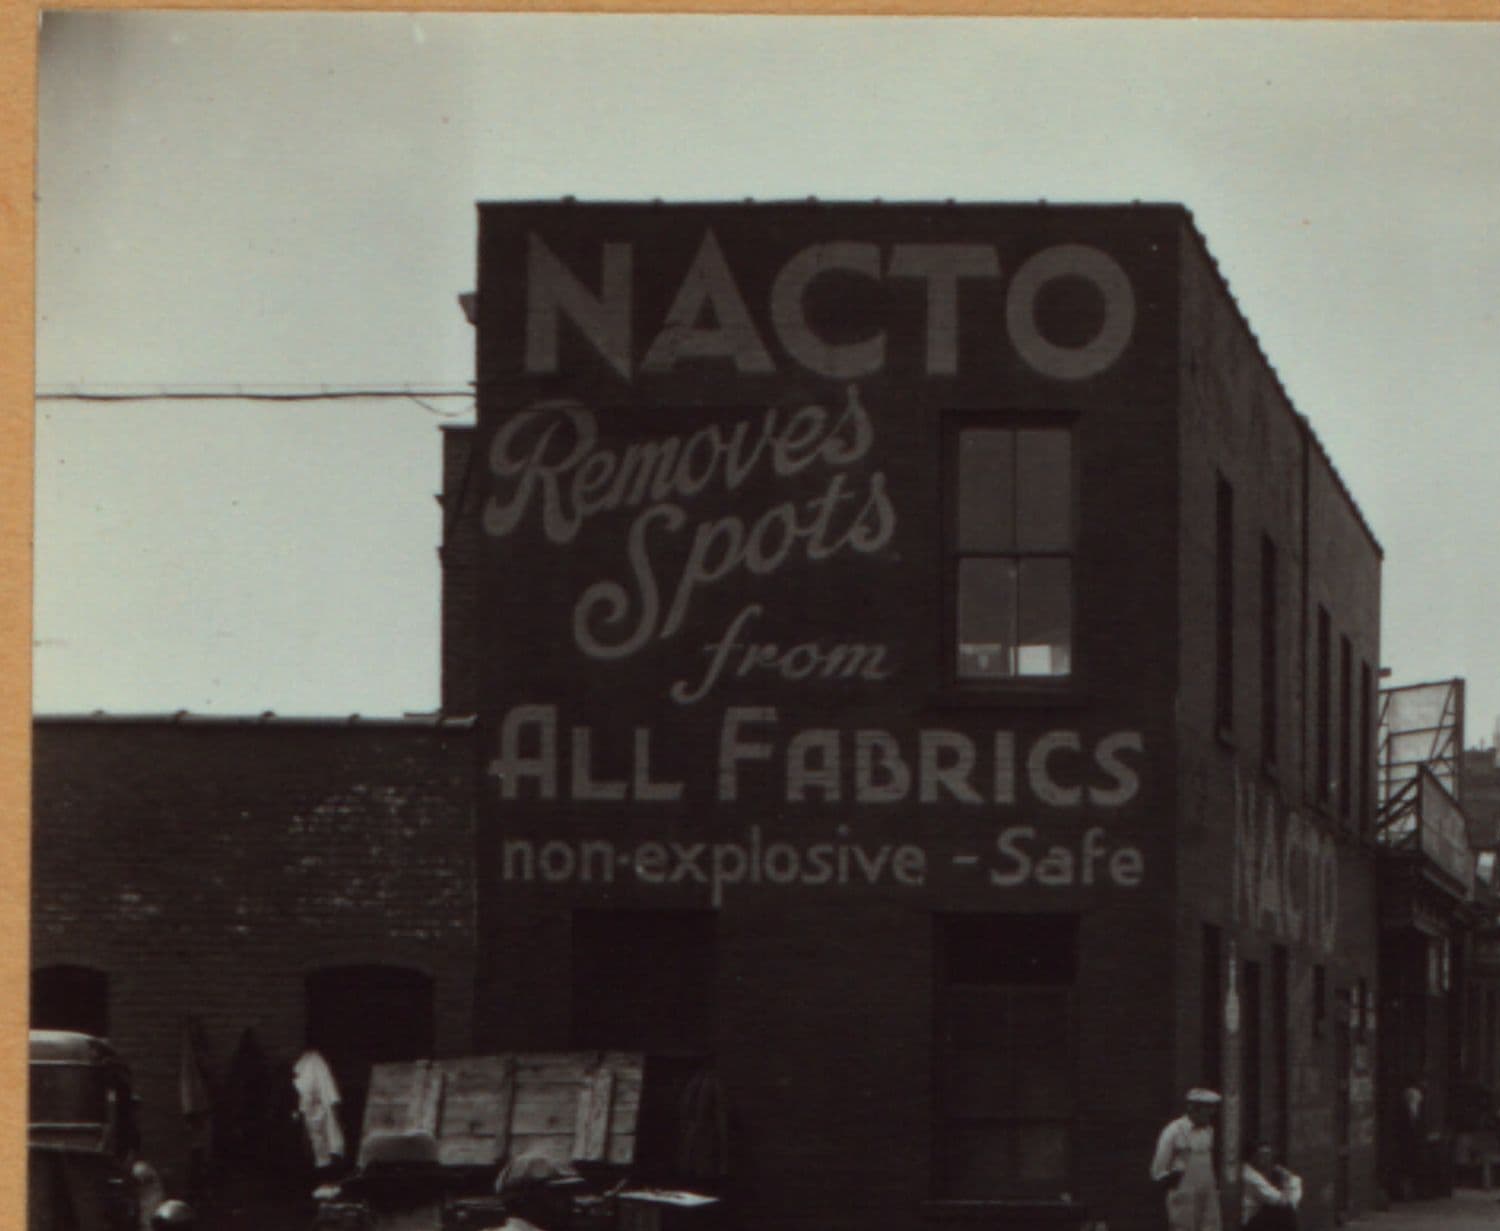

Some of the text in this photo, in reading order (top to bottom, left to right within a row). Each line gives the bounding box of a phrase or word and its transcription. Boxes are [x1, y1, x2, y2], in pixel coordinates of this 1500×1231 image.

[523, 227, 1136, 382] NACTO
[483, 388, 876, 544] Removes
[573, 472, 896, 659] Spots
[670, 604, 893, 705] from
[990, 826, 1146, 889] Safe
